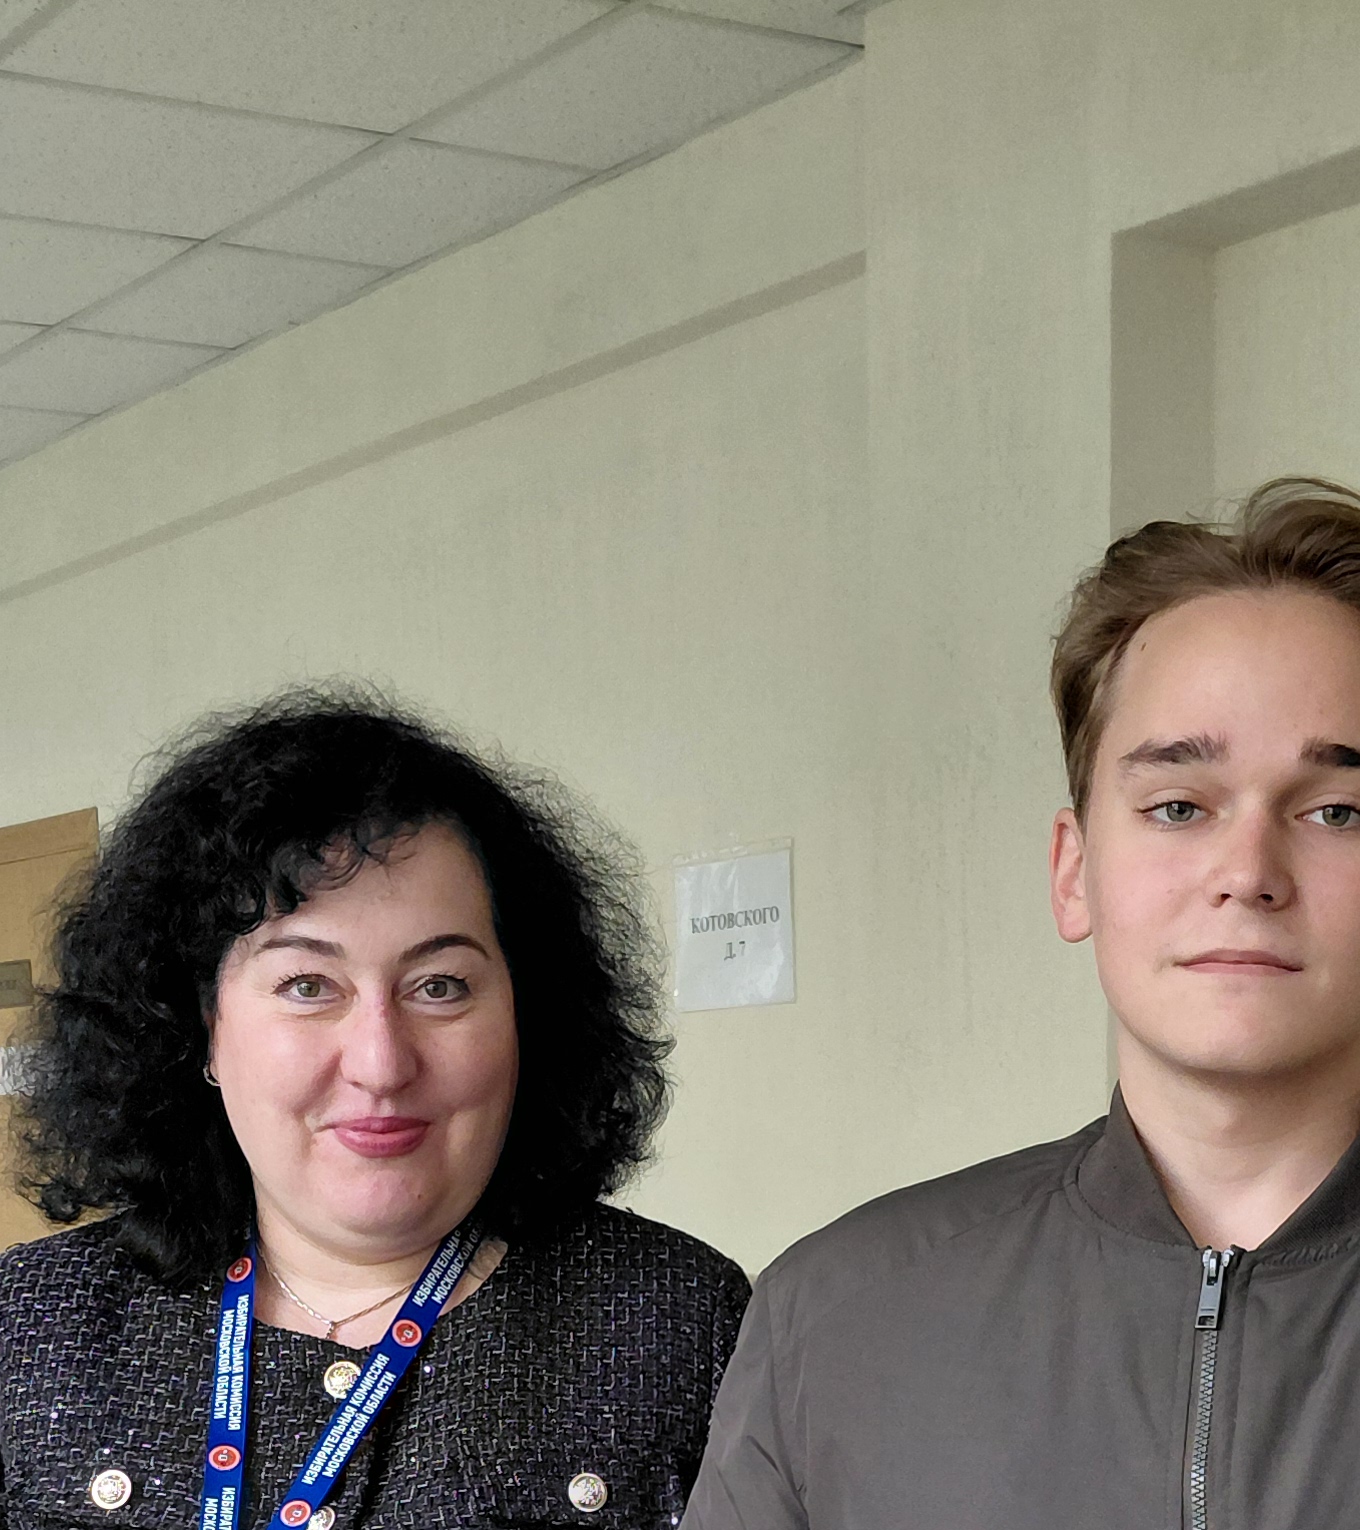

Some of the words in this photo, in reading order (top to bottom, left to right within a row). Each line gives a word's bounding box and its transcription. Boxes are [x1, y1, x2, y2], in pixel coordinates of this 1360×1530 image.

[690, 906, 779, 934] КОТОВСКОГО
[218, 1309, 235, 1374] МОСКОВСКОЙ
[232, 1294, 249, 1374] ИЗБИРАТЕЛЬНАЯ
[214, 1375, 228, 1419] ОБЛАСТИ
[228, 1375, 244, 1430] КОМИССИЯ
[301, 1405, 358, 1485] ИЗБИРАТЕЛЬНАЯ
[349, 1353, 390, 1407] КОМИССИЯ
[322, 1412, 371, 1478] МОСКОВСКОЙ
[362, 1371, 397, 1415] ОБЛАСТИ
